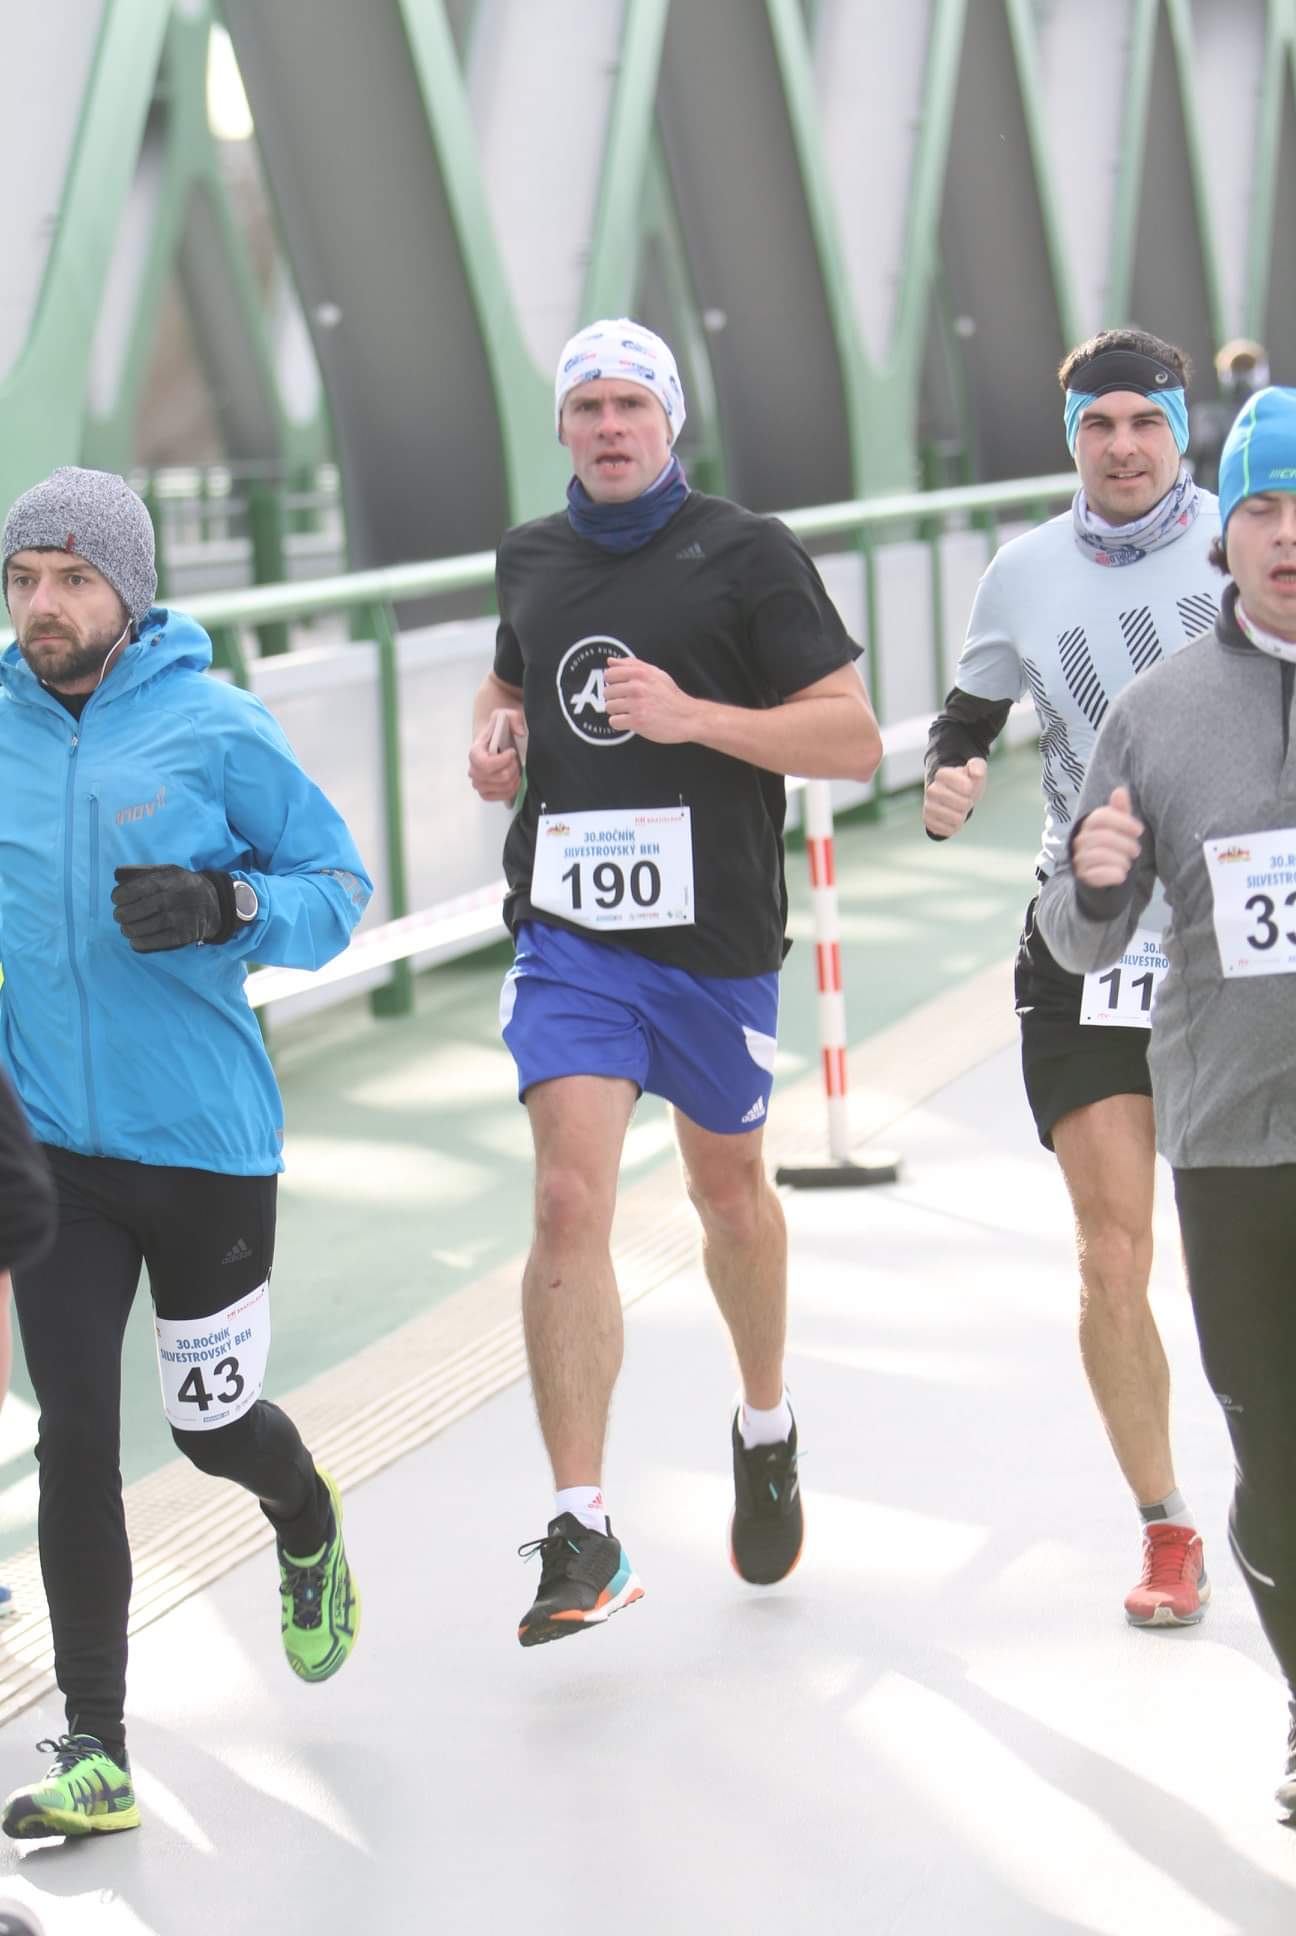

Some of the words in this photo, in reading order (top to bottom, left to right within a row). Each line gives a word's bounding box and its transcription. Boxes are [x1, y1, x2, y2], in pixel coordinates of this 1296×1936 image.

[583, 722, 616, 735] BRATIS
[583, 827, 636, 843] 30.ROČNÍK
[563, 842, 636, 859] SILVESTROVSKÝ
[639, 842, 661, 856] BEH
[561, 860, 662, 910] 190
[1143, 942, 1161, 954] 30.
[1098, 967, 1154, 1011] 11
[176, 1327, 231, 1350] 30.ROČNÍK
[234, 1328, 252, 1346] BEH
[177, 1355, 245, 1412] 43
